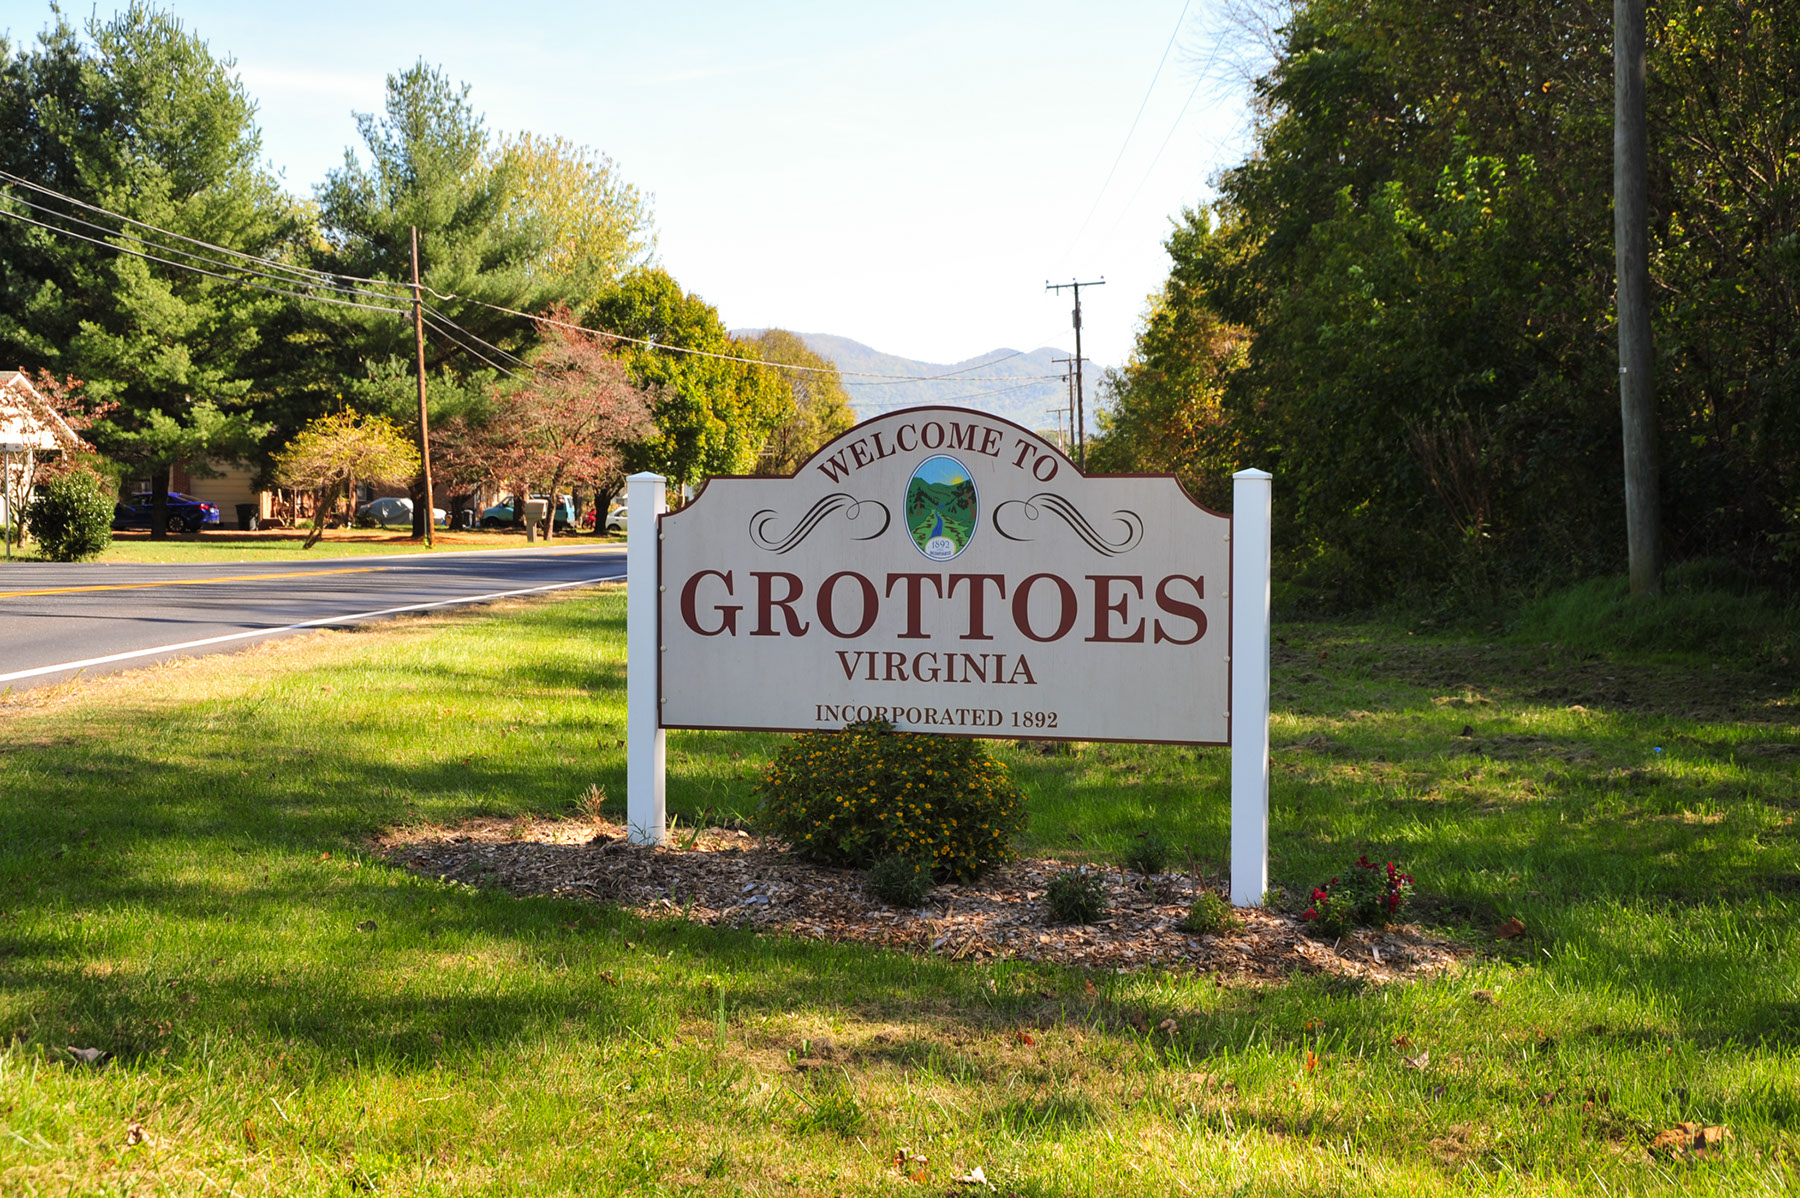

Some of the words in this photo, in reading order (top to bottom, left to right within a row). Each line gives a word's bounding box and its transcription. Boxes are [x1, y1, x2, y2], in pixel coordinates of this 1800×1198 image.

[816, 421, 1003, 484] WELCOME
[1012, 439, 1059, 482] TO
[931, 540, 950, 549] 1892
[680, 569, 1208, 645] GROTTOES
[835, 650, 1038, 685] VIRGINIA
[815, 704, 1003, 727] INCORPORATED
[1011, 710, 1057, 728] 1892
